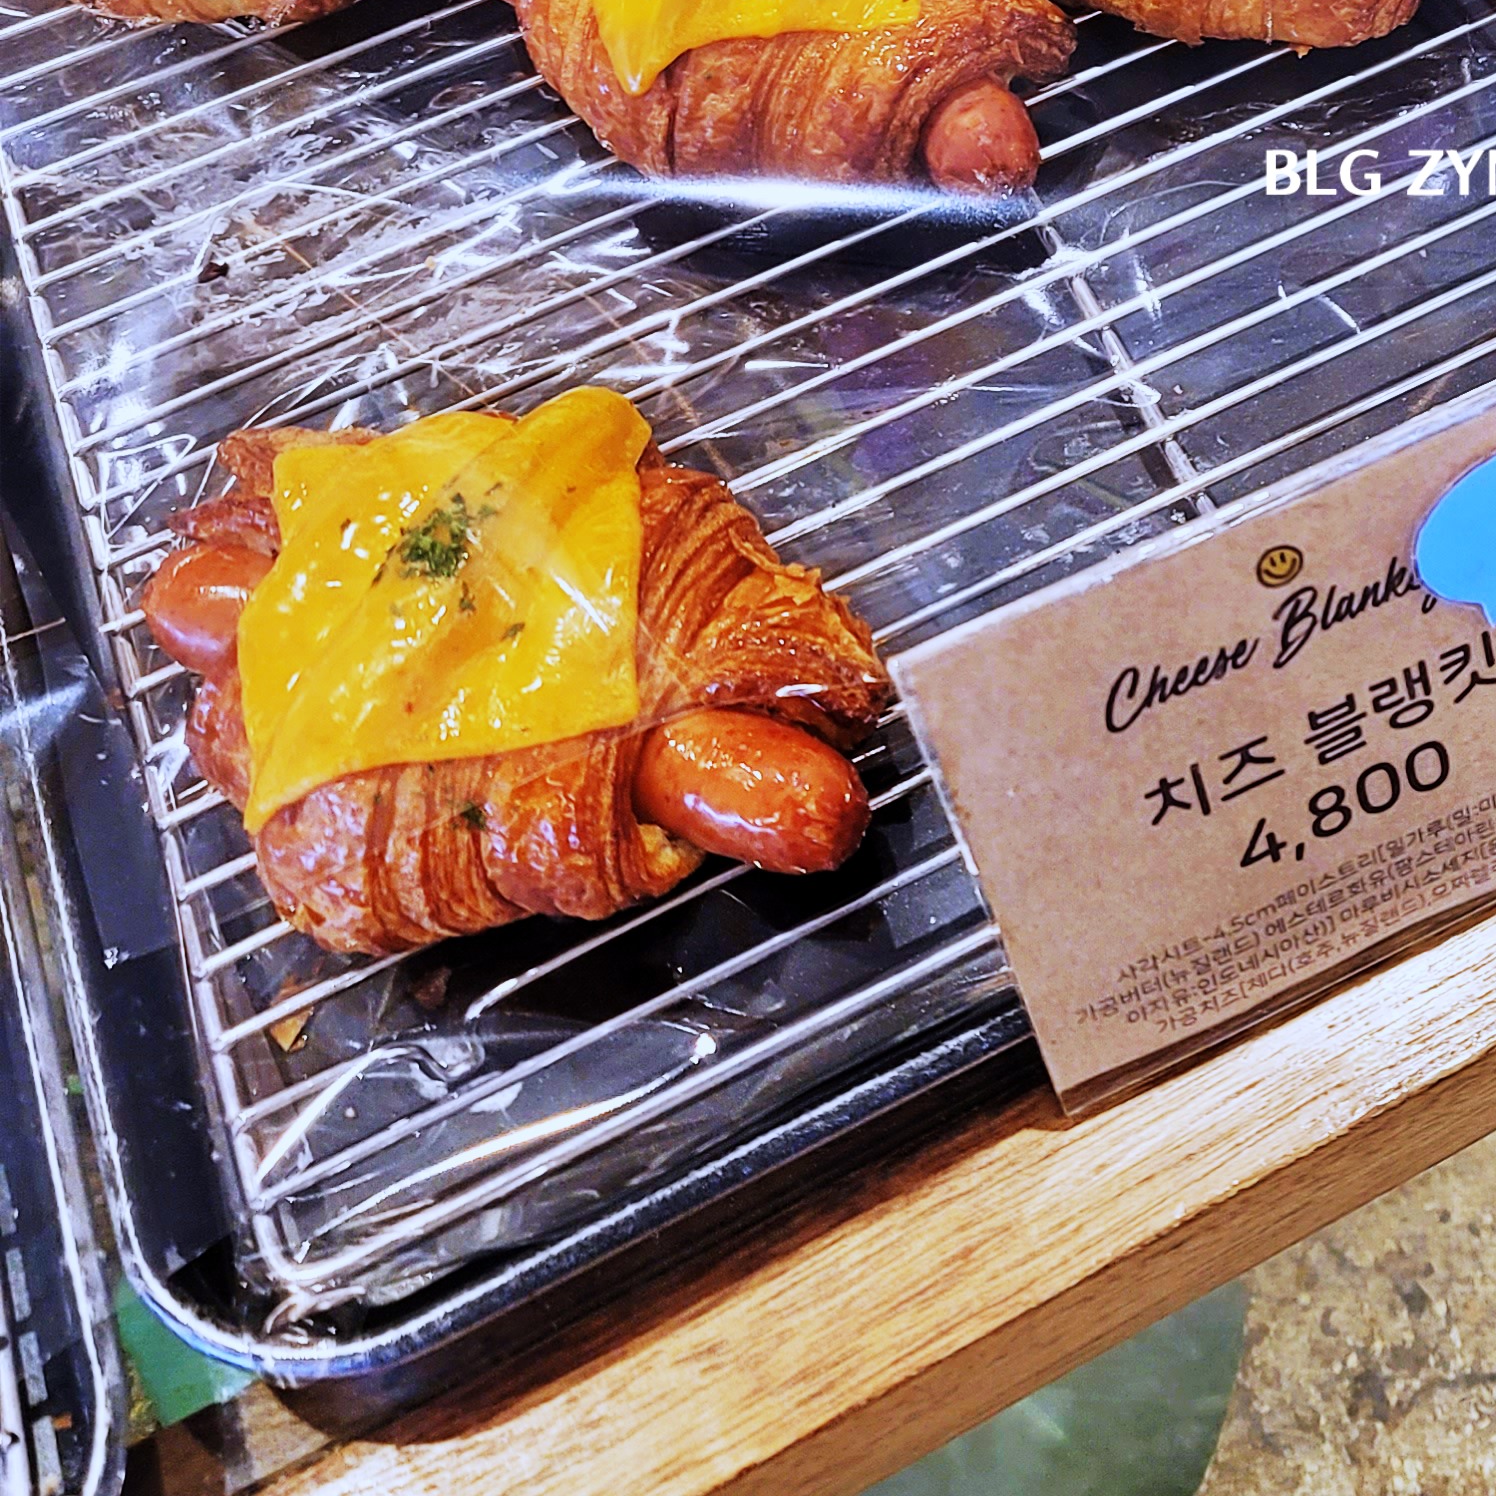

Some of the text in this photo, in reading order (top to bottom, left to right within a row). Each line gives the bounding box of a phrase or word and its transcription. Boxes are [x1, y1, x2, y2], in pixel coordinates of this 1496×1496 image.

[1104, 638, 1258, 733] Cheese
[1144, 735, 1285, 825] 치즈
[1239, 740, 1449, 867] 4,800
